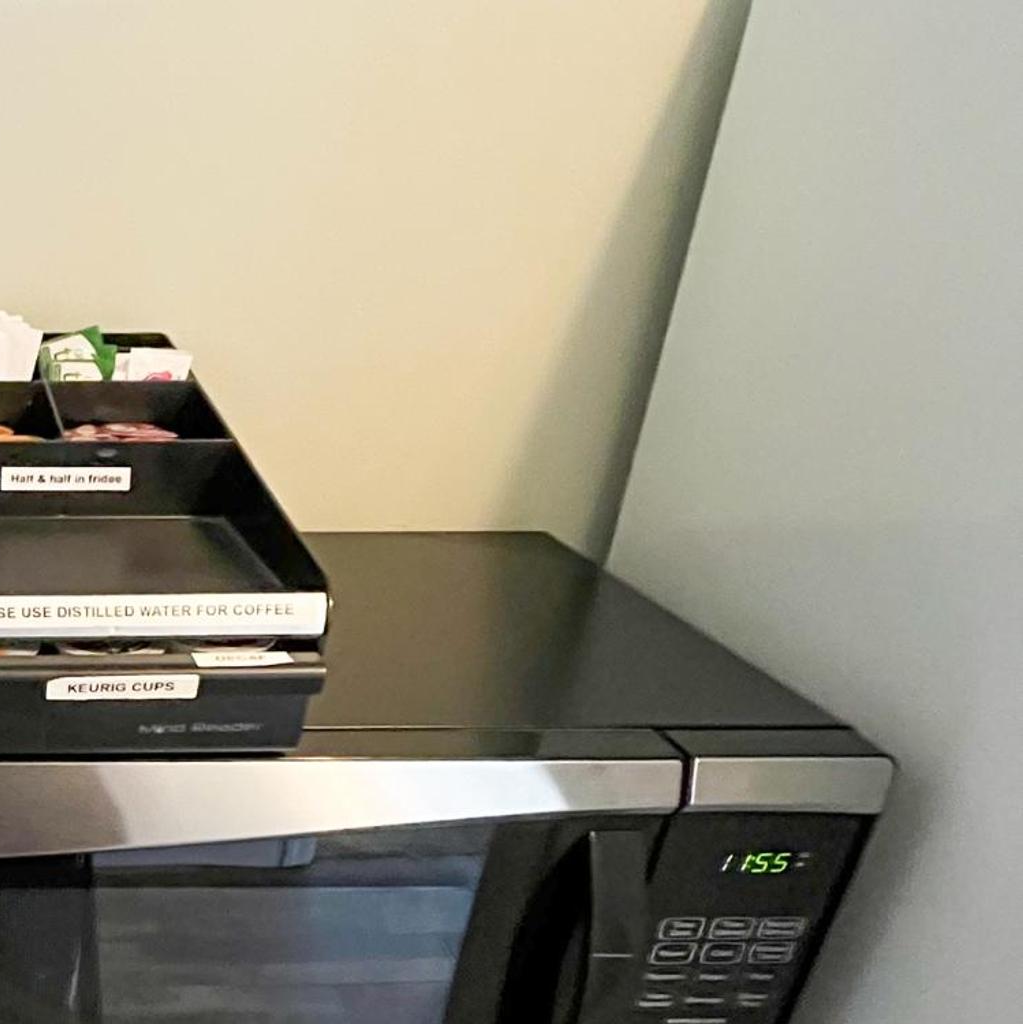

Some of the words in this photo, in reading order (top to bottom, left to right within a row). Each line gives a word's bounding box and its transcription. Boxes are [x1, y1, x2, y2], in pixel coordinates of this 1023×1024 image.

[11, 474, 34, 483] Half
[37, 475, 46, 483] &
[50, 474, 71, 483] half
[75, 474, 85, 483] in
[22, 606, 52, 618] USE
[57, 605, 135, 618] DISTILLED
[140, 605, 191, 617] WATER
[197, 604, 228, 616] FOR
[233, 603, 295, 616] COFFEE
[67, 682, 127, 693] KEURIG
[132, 681, 175, 692] CUPS
